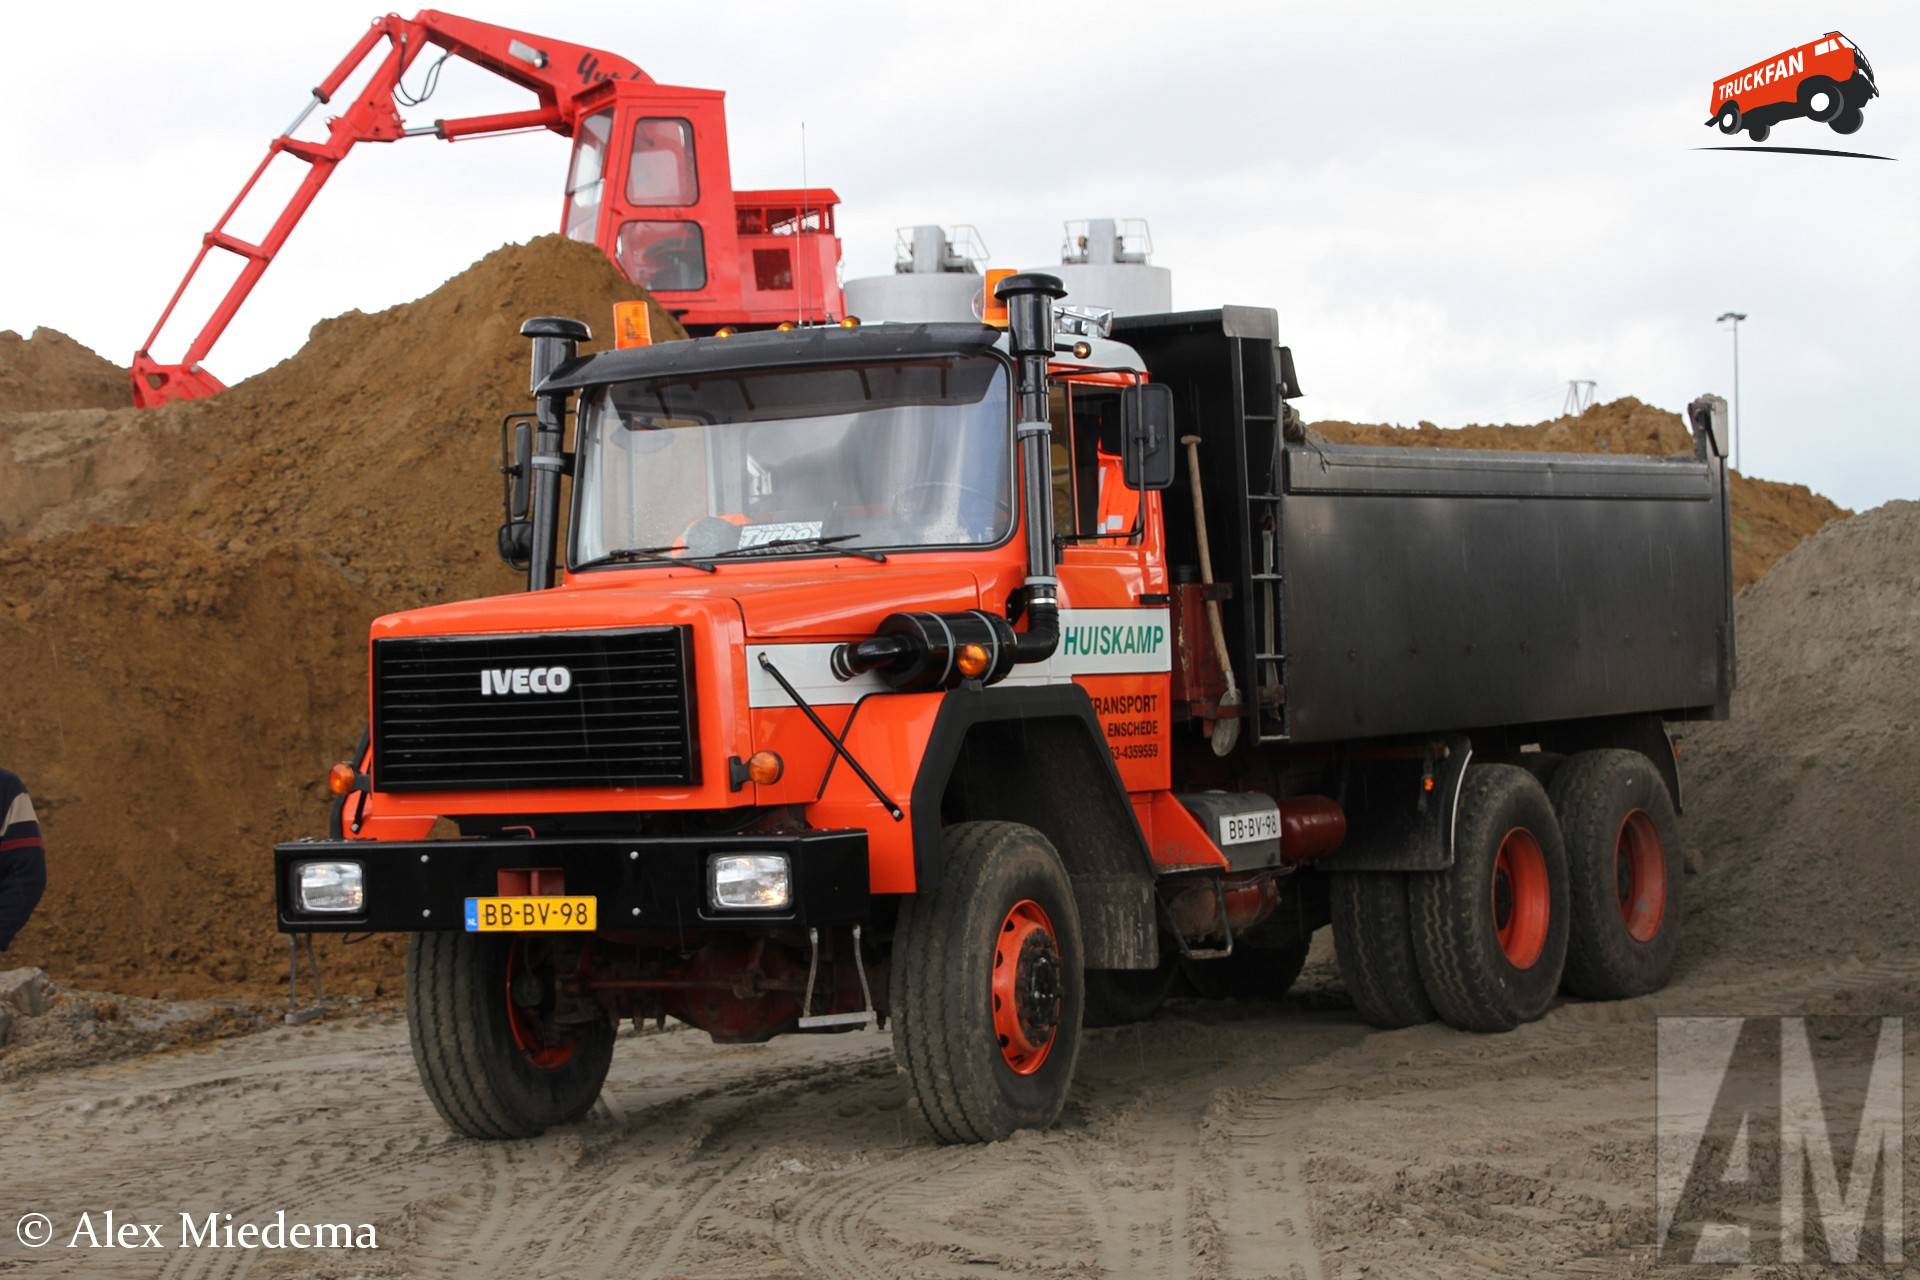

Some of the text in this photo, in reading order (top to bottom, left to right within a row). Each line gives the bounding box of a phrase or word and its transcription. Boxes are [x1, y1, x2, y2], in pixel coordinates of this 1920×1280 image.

[742, 526, 812, 548] Turbo
[1064, 625, 1164, 655] HUISKAMP
[481, 666, 571, 695] IVECO
[1107, 720, 1159, 737] ENSCHEDE
[1229, 815, 1277, 840] BB-BV-98
[485, 903, 588, 926] BB-BV-98
